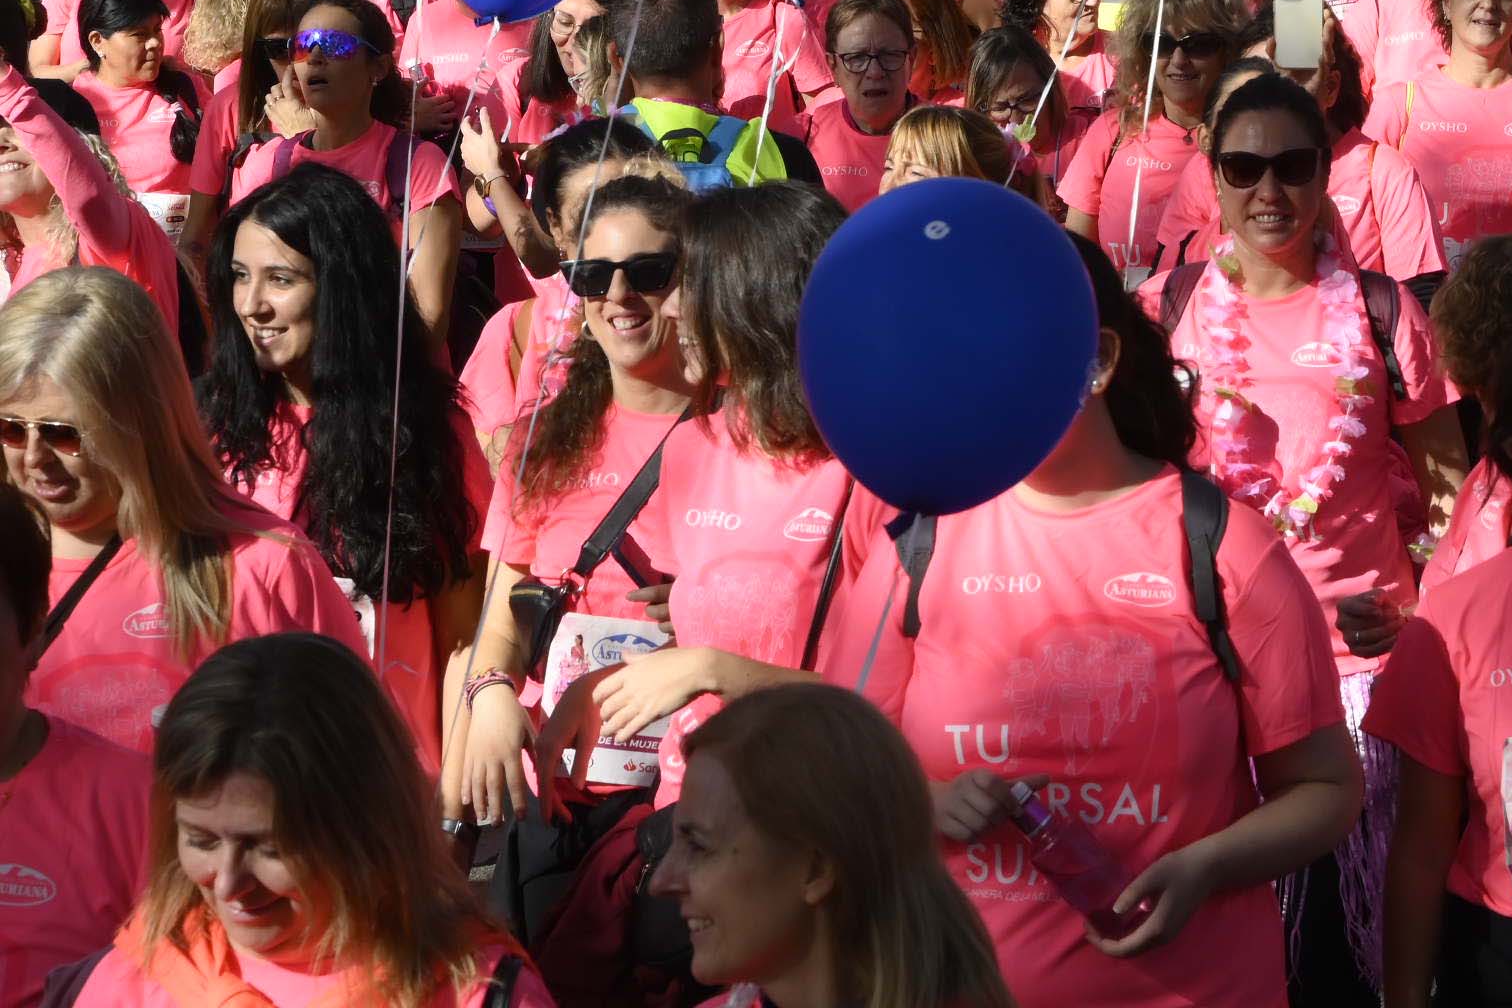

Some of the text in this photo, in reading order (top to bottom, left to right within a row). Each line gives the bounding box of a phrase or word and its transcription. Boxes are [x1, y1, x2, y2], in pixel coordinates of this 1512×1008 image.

[1420, 120, 1467, 133] OYSHO
[822, 167, 868, 177] OYSHO
[962, 573, 1042, 595] OYSHO
[1110, 584, 1174, 600] ASTURIANA
[629, 739, 660, 750] MUJE
[945, 724, 1010, 765] TU
[1047, 782, 1169, 826] RSAL
[965, 843, 1039, 886] SU
[0, 881, 49, 900] URIANA
